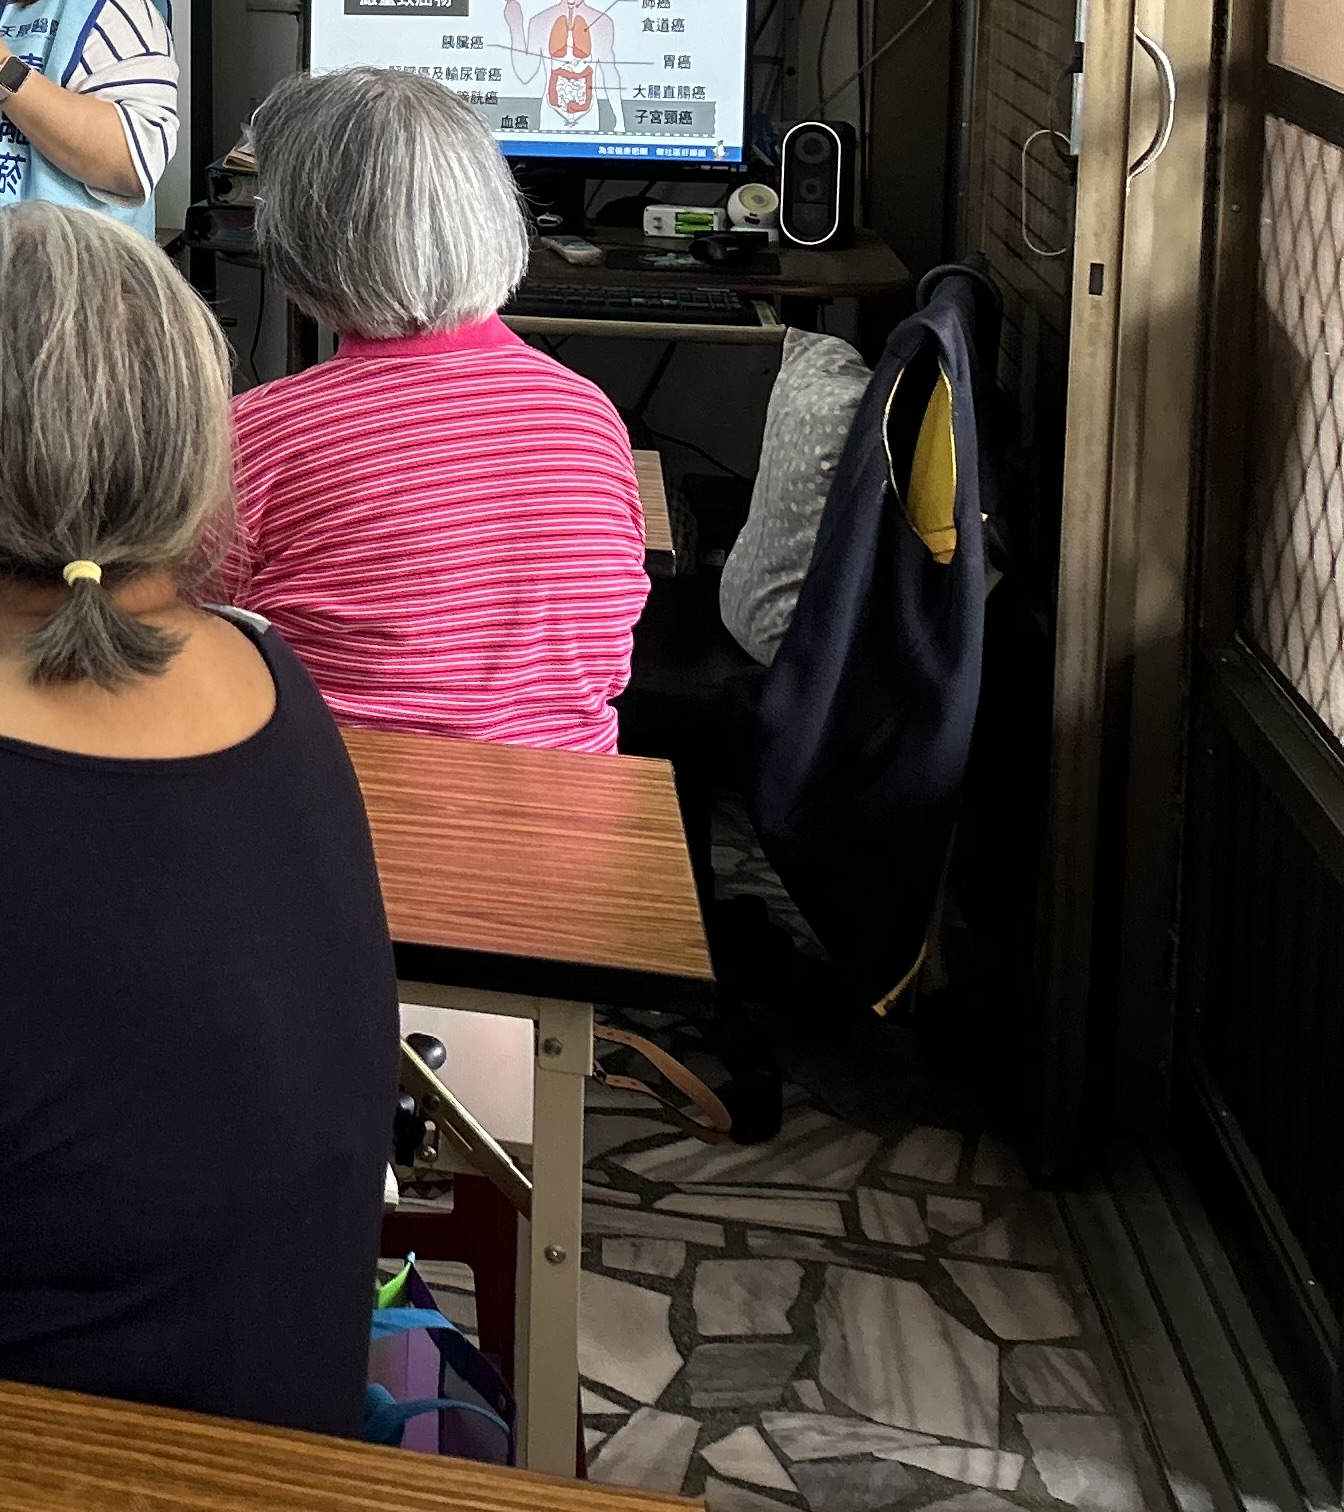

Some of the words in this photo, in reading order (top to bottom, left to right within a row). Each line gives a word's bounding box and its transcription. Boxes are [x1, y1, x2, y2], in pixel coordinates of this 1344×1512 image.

[641, 17, 686, 33] 食道癌
[663, 54, 692, 70] 胃癌
[500, 114, 529, 130] 血癌
[633, 109, 694, 126] 子宮頸癌
